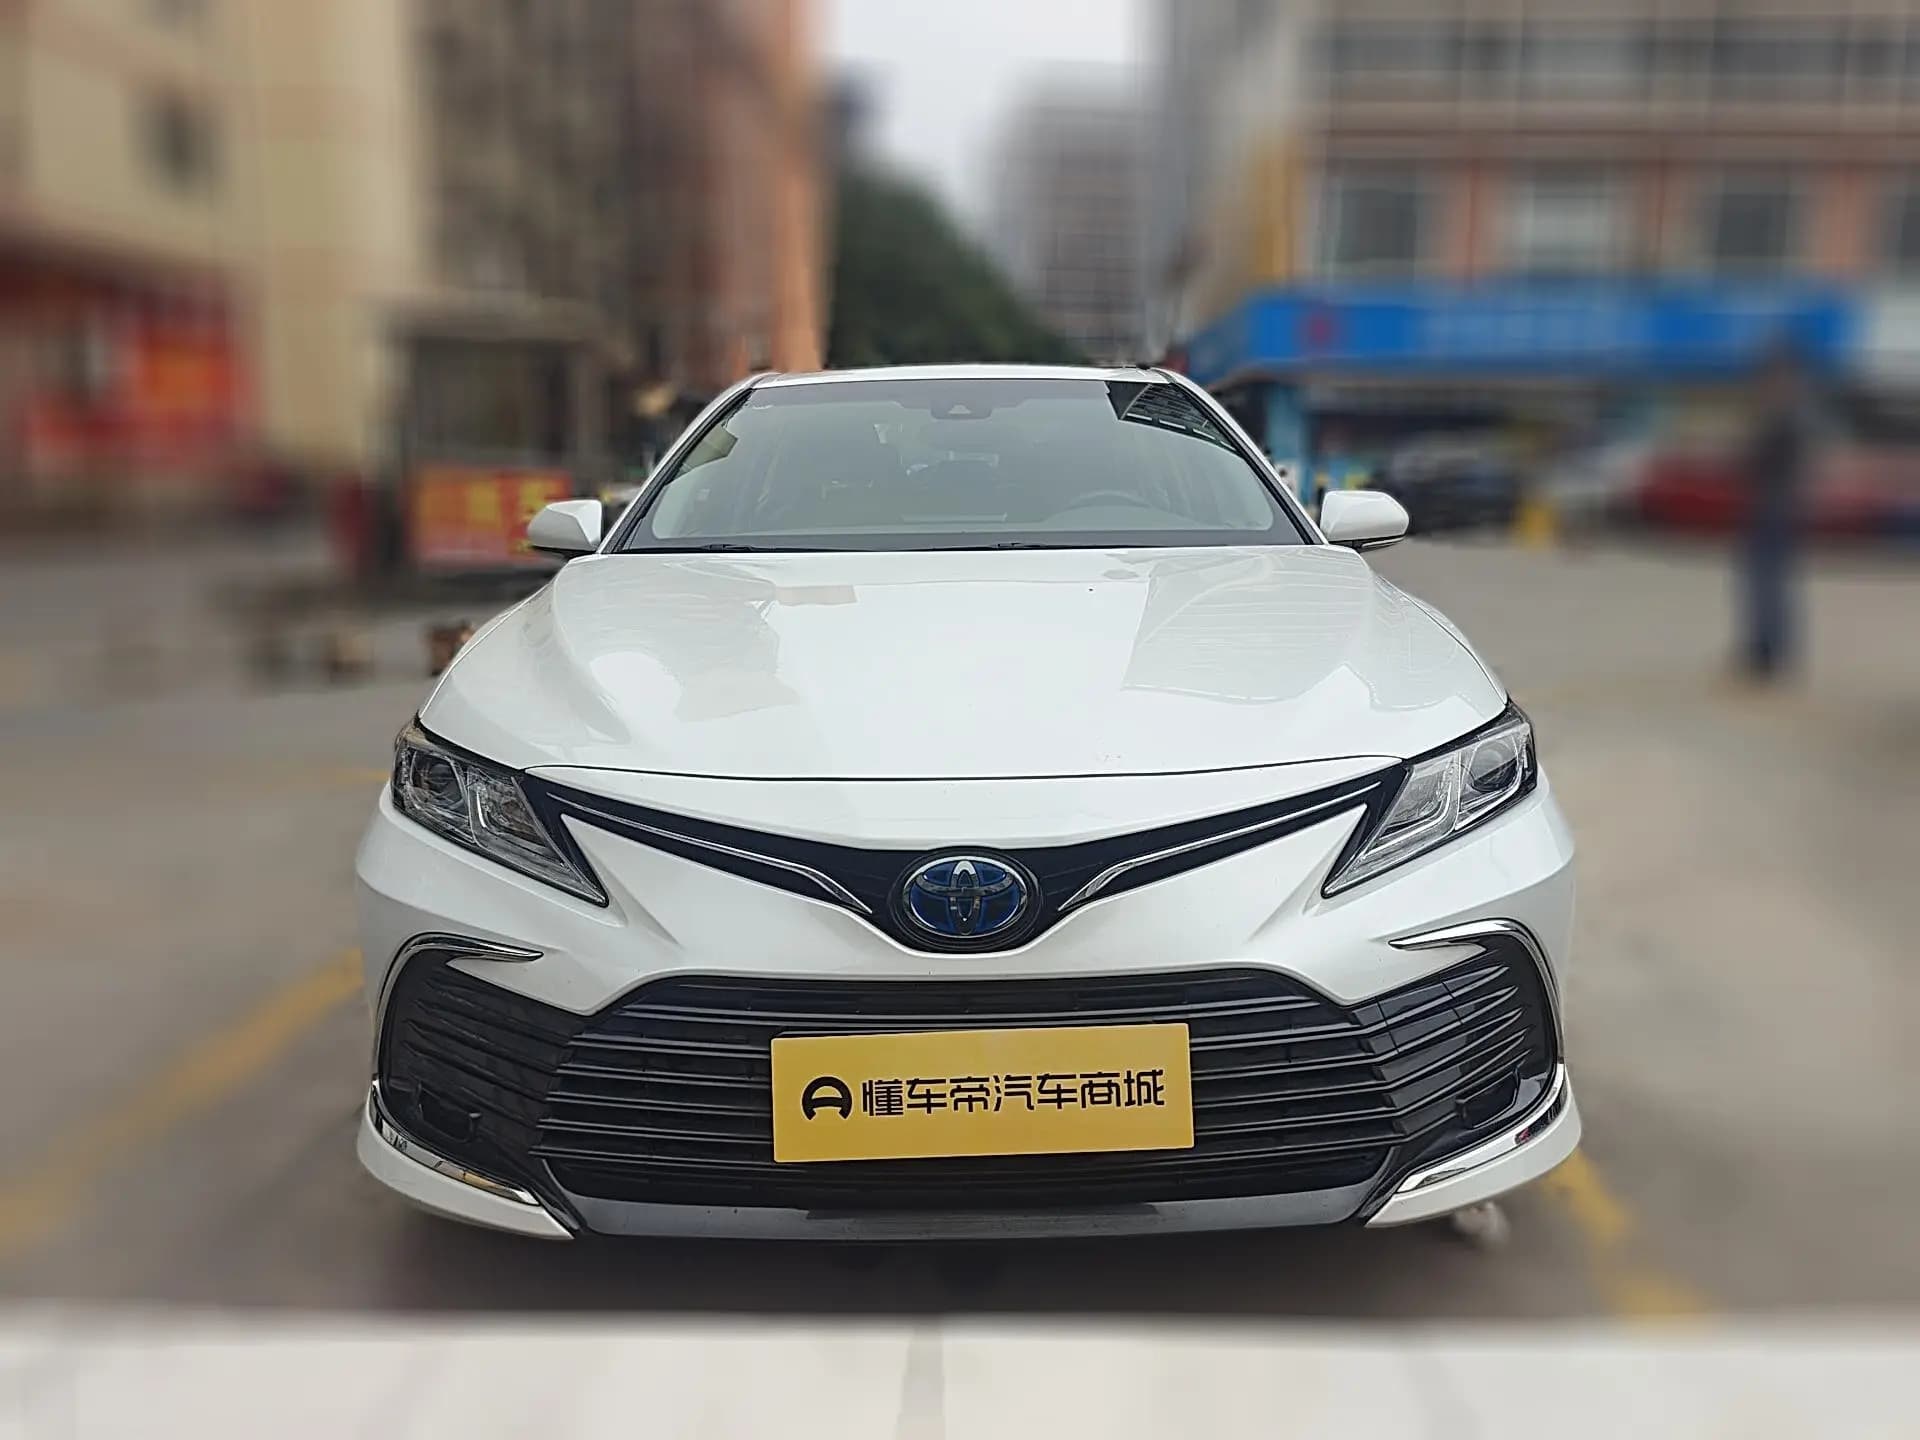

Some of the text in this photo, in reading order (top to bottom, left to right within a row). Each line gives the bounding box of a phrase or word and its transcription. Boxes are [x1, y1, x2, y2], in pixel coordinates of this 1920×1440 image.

[862, 1069, 1165, 1116] 懂车帝汽车商城
